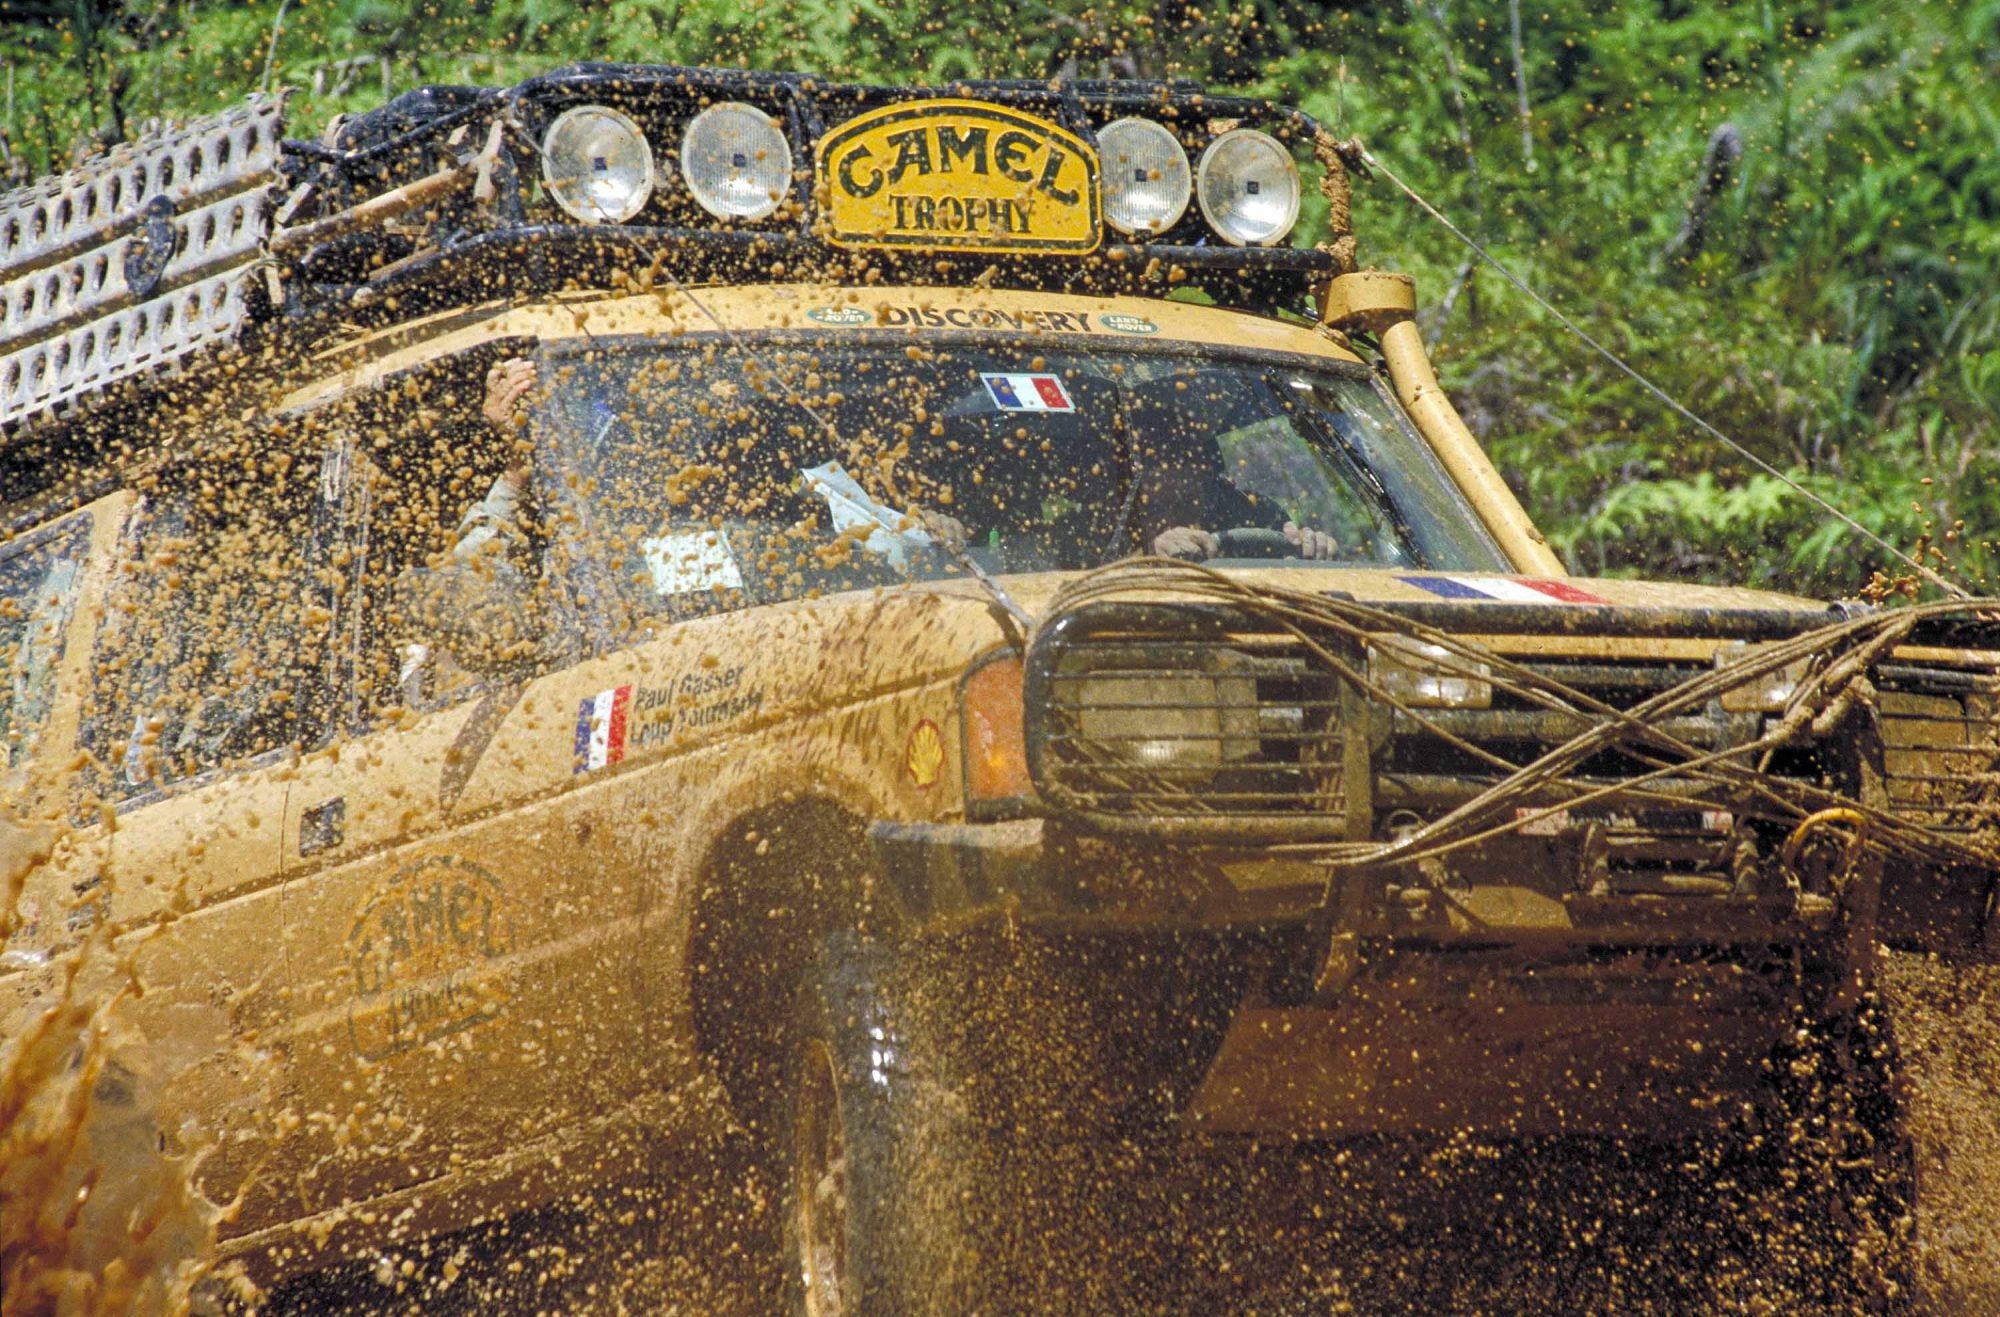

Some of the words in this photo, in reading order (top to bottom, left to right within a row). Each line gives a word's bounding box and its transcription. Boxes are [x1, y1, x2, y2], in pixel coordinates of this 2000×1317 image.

[839, 125, 1080, 206] CAMEL
[888, 195, 1035, 234] TROPHY
[887, 307, 1094, 333] DISCOVERY
[634, 679, 675, 712] Paul
